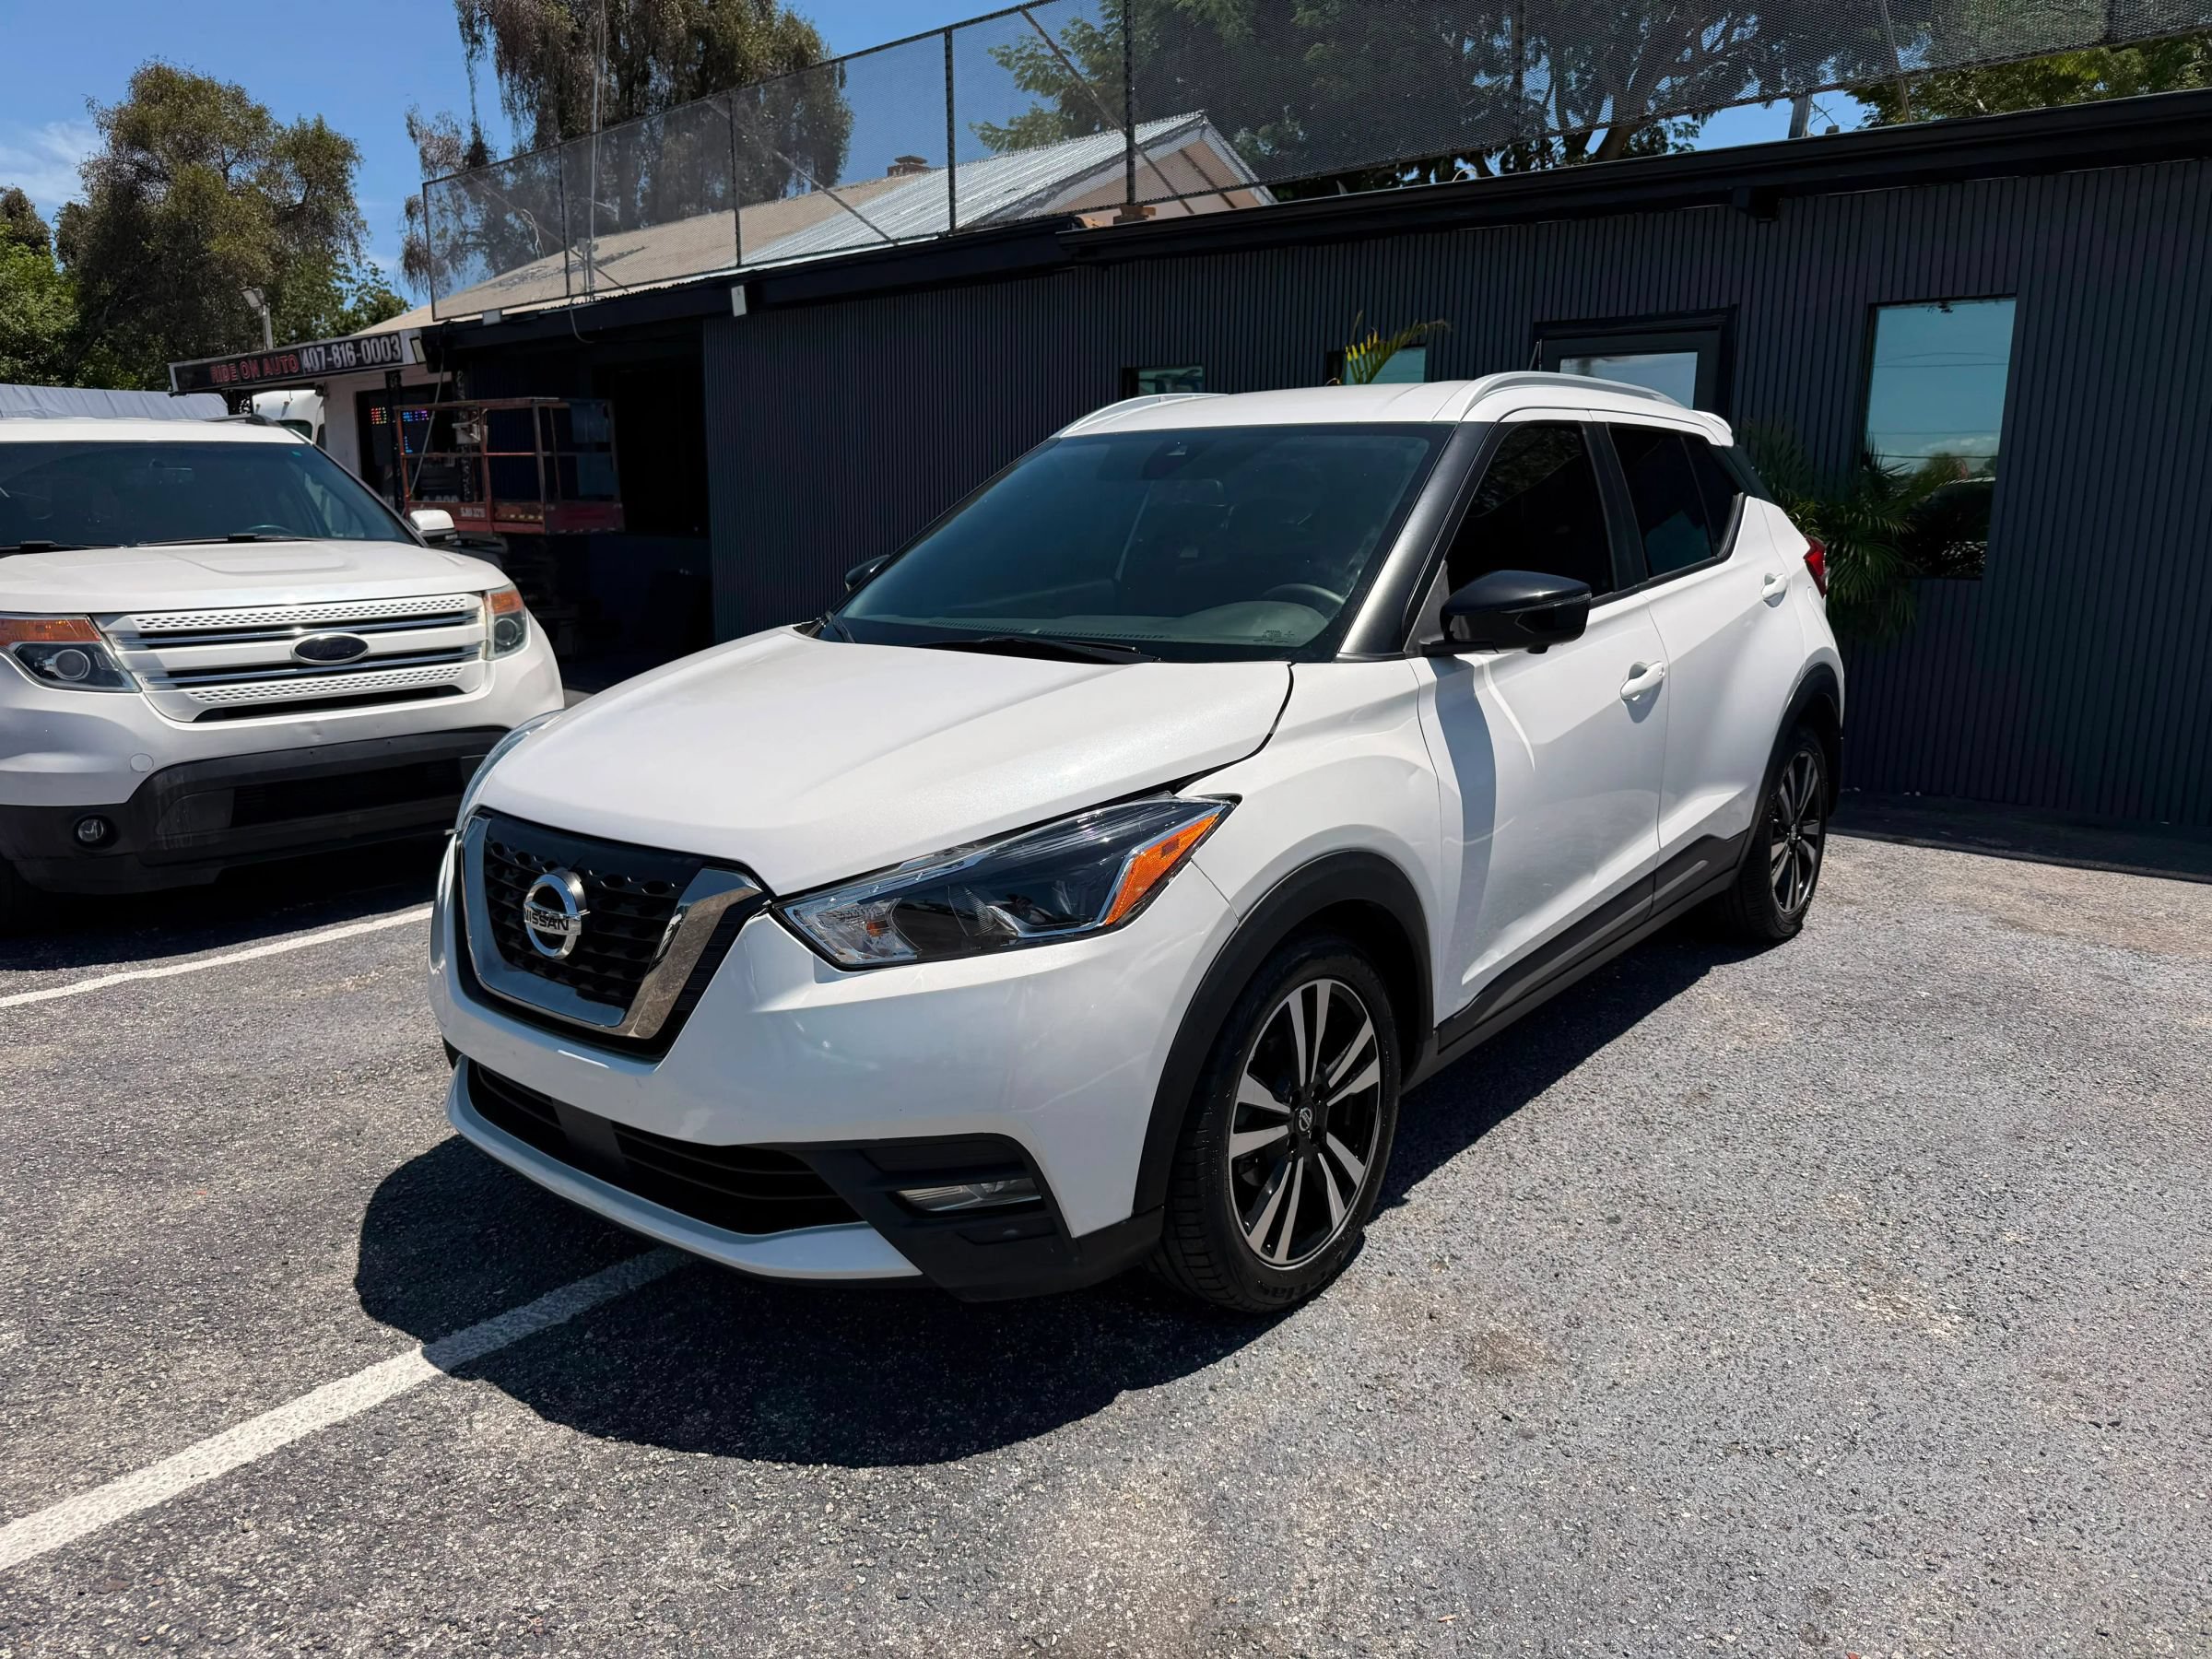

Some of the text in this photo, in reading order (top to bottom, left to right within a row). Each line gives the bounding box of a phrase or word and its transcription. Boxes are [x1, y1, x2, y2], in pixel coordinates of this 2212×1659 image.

[240, 360, 261, 380] ON
[264, 353, 300, 376] AUTO
[302, 335, 401, 372] 407-816-0003
[524, 908, 570, 931] NISSAN
